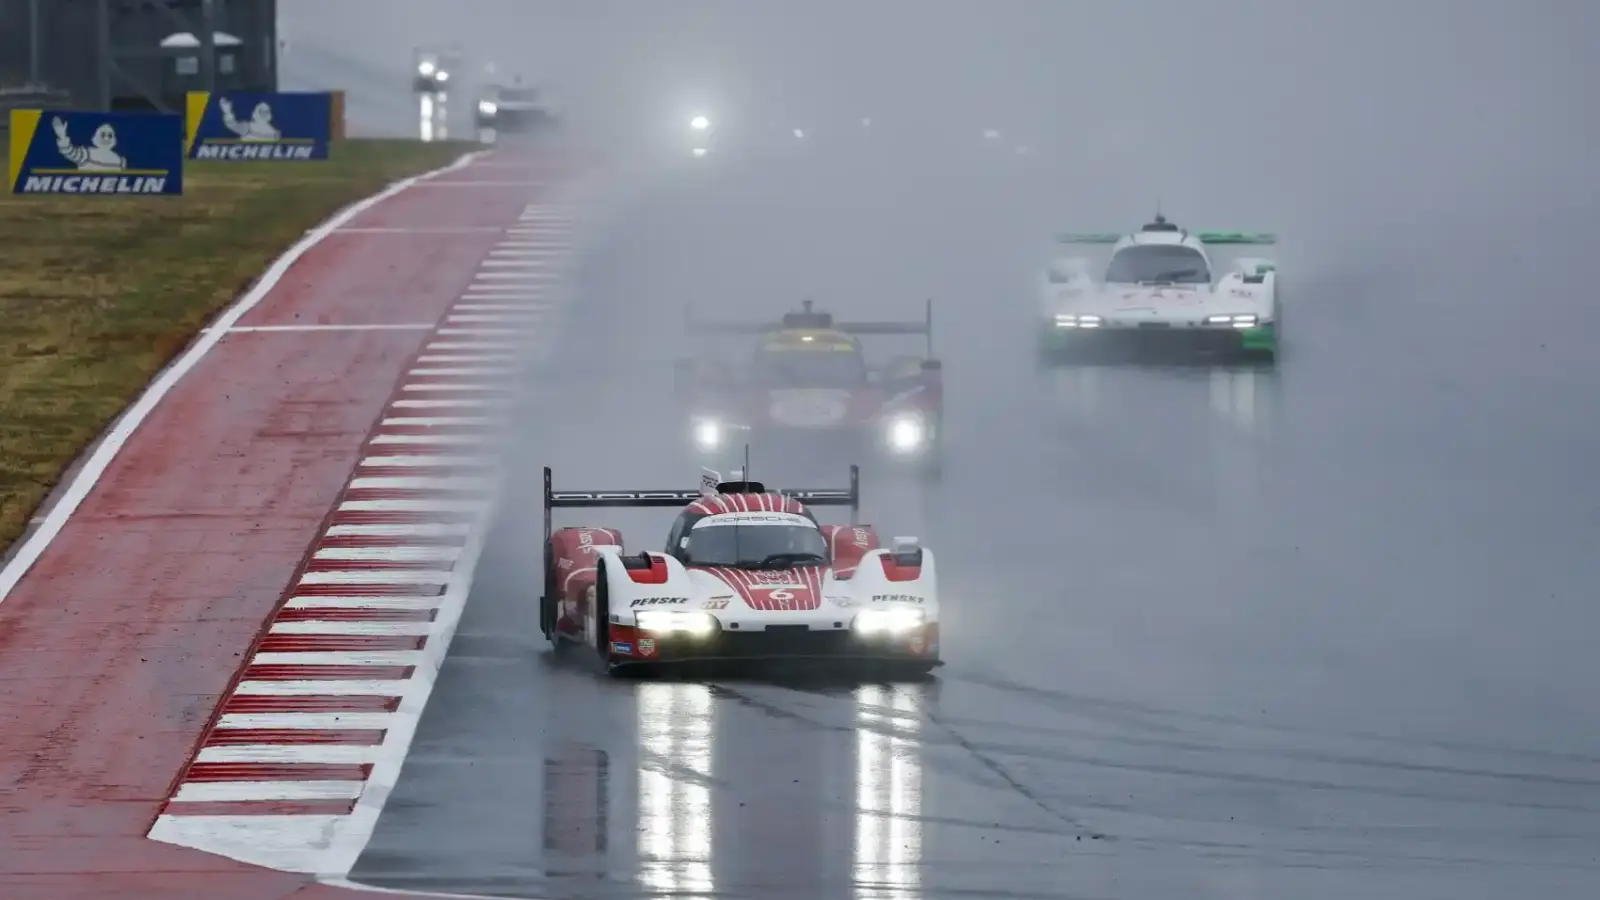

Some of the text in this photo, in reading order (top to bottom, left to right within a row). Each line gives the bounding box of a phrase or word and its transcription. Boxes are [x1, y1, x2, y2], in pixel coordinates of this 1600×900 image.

[197, 144, 313, 158] MICHELIN
[25, 177, 164, 192] MICHELIN
[769, 589, 794, 600] 6
[630, 598, 688, 607] PENSKE
